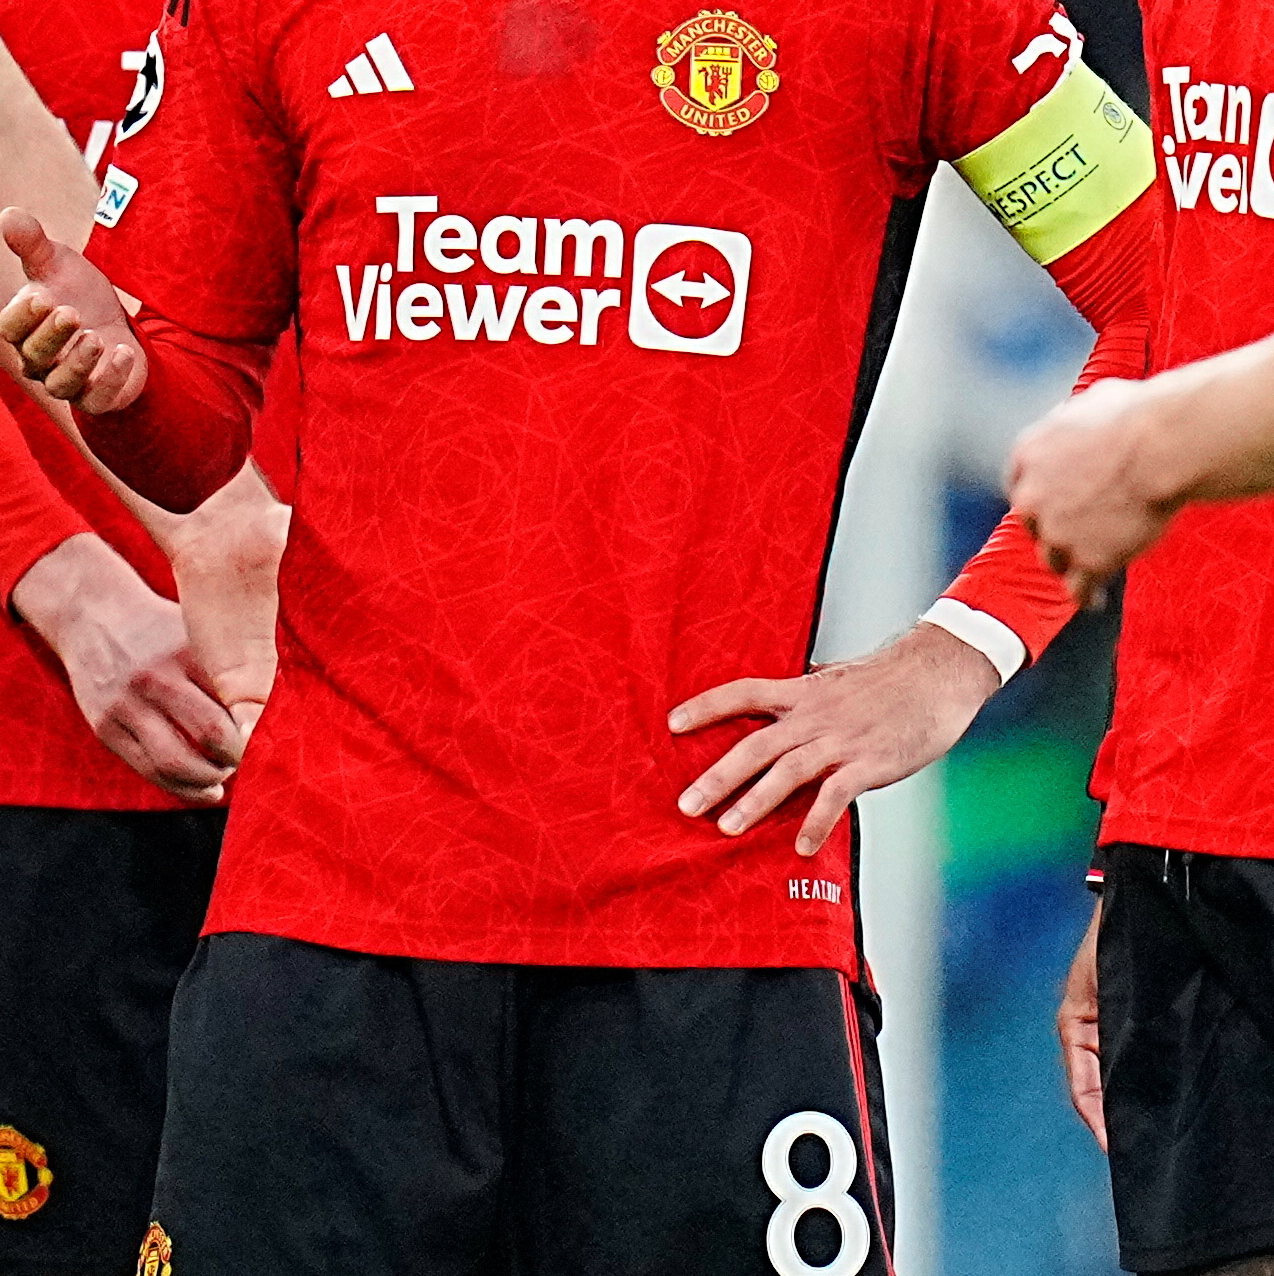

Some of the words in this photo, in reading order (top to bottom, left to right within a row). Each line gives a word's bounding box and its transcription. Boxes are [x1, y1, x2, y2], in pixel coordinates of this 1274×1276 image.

[666, 19, 768, 62] MANCHESTER
[680, 104, 751, 128] UNITED
[376, 195, 624, 278] Team
[336, 262, 621, 346] Viewer
[762, 1110, 870, 1276] 8
